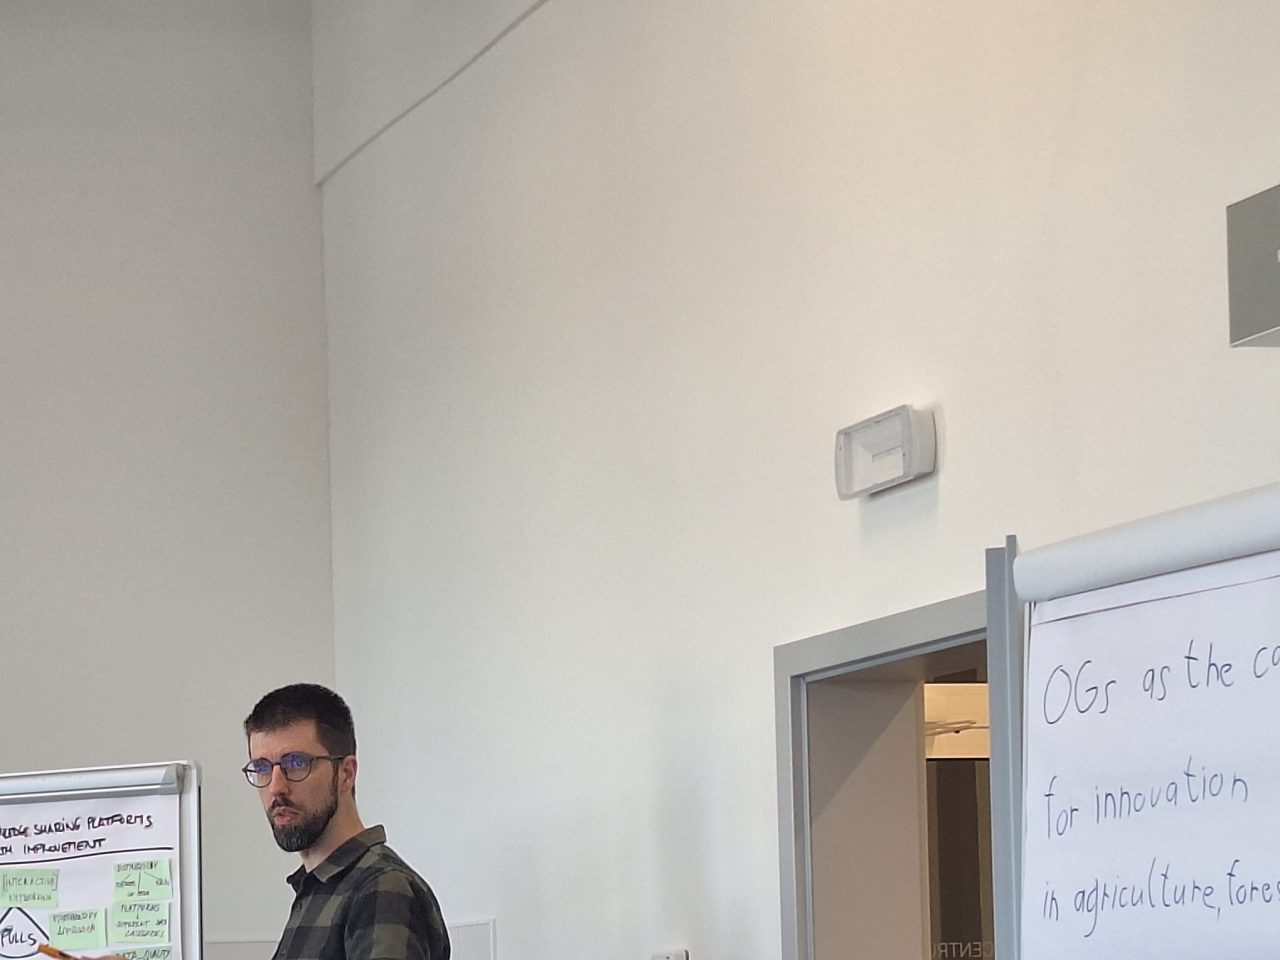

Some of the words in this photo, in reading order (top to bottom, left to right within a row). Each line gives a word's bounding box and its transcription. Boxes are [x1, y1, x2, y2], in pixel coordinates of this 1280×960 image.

[1044, 660, 1116, 725] OGs
[1142, 665, 1171, 701] as
[1184, 639, 1234, 689] the
[1044, 775, 1079, 839] for
[1095, 755, 1248, 825] innovation
[87, 813, 153, 831] PLATFORMS
[23, 838, 106, 855] IMPROVEMENT
[1043, 881, 1059, 921] in
[1227, 858, 1280, 907] fore
[1, 927, 38, 948] PULLS
